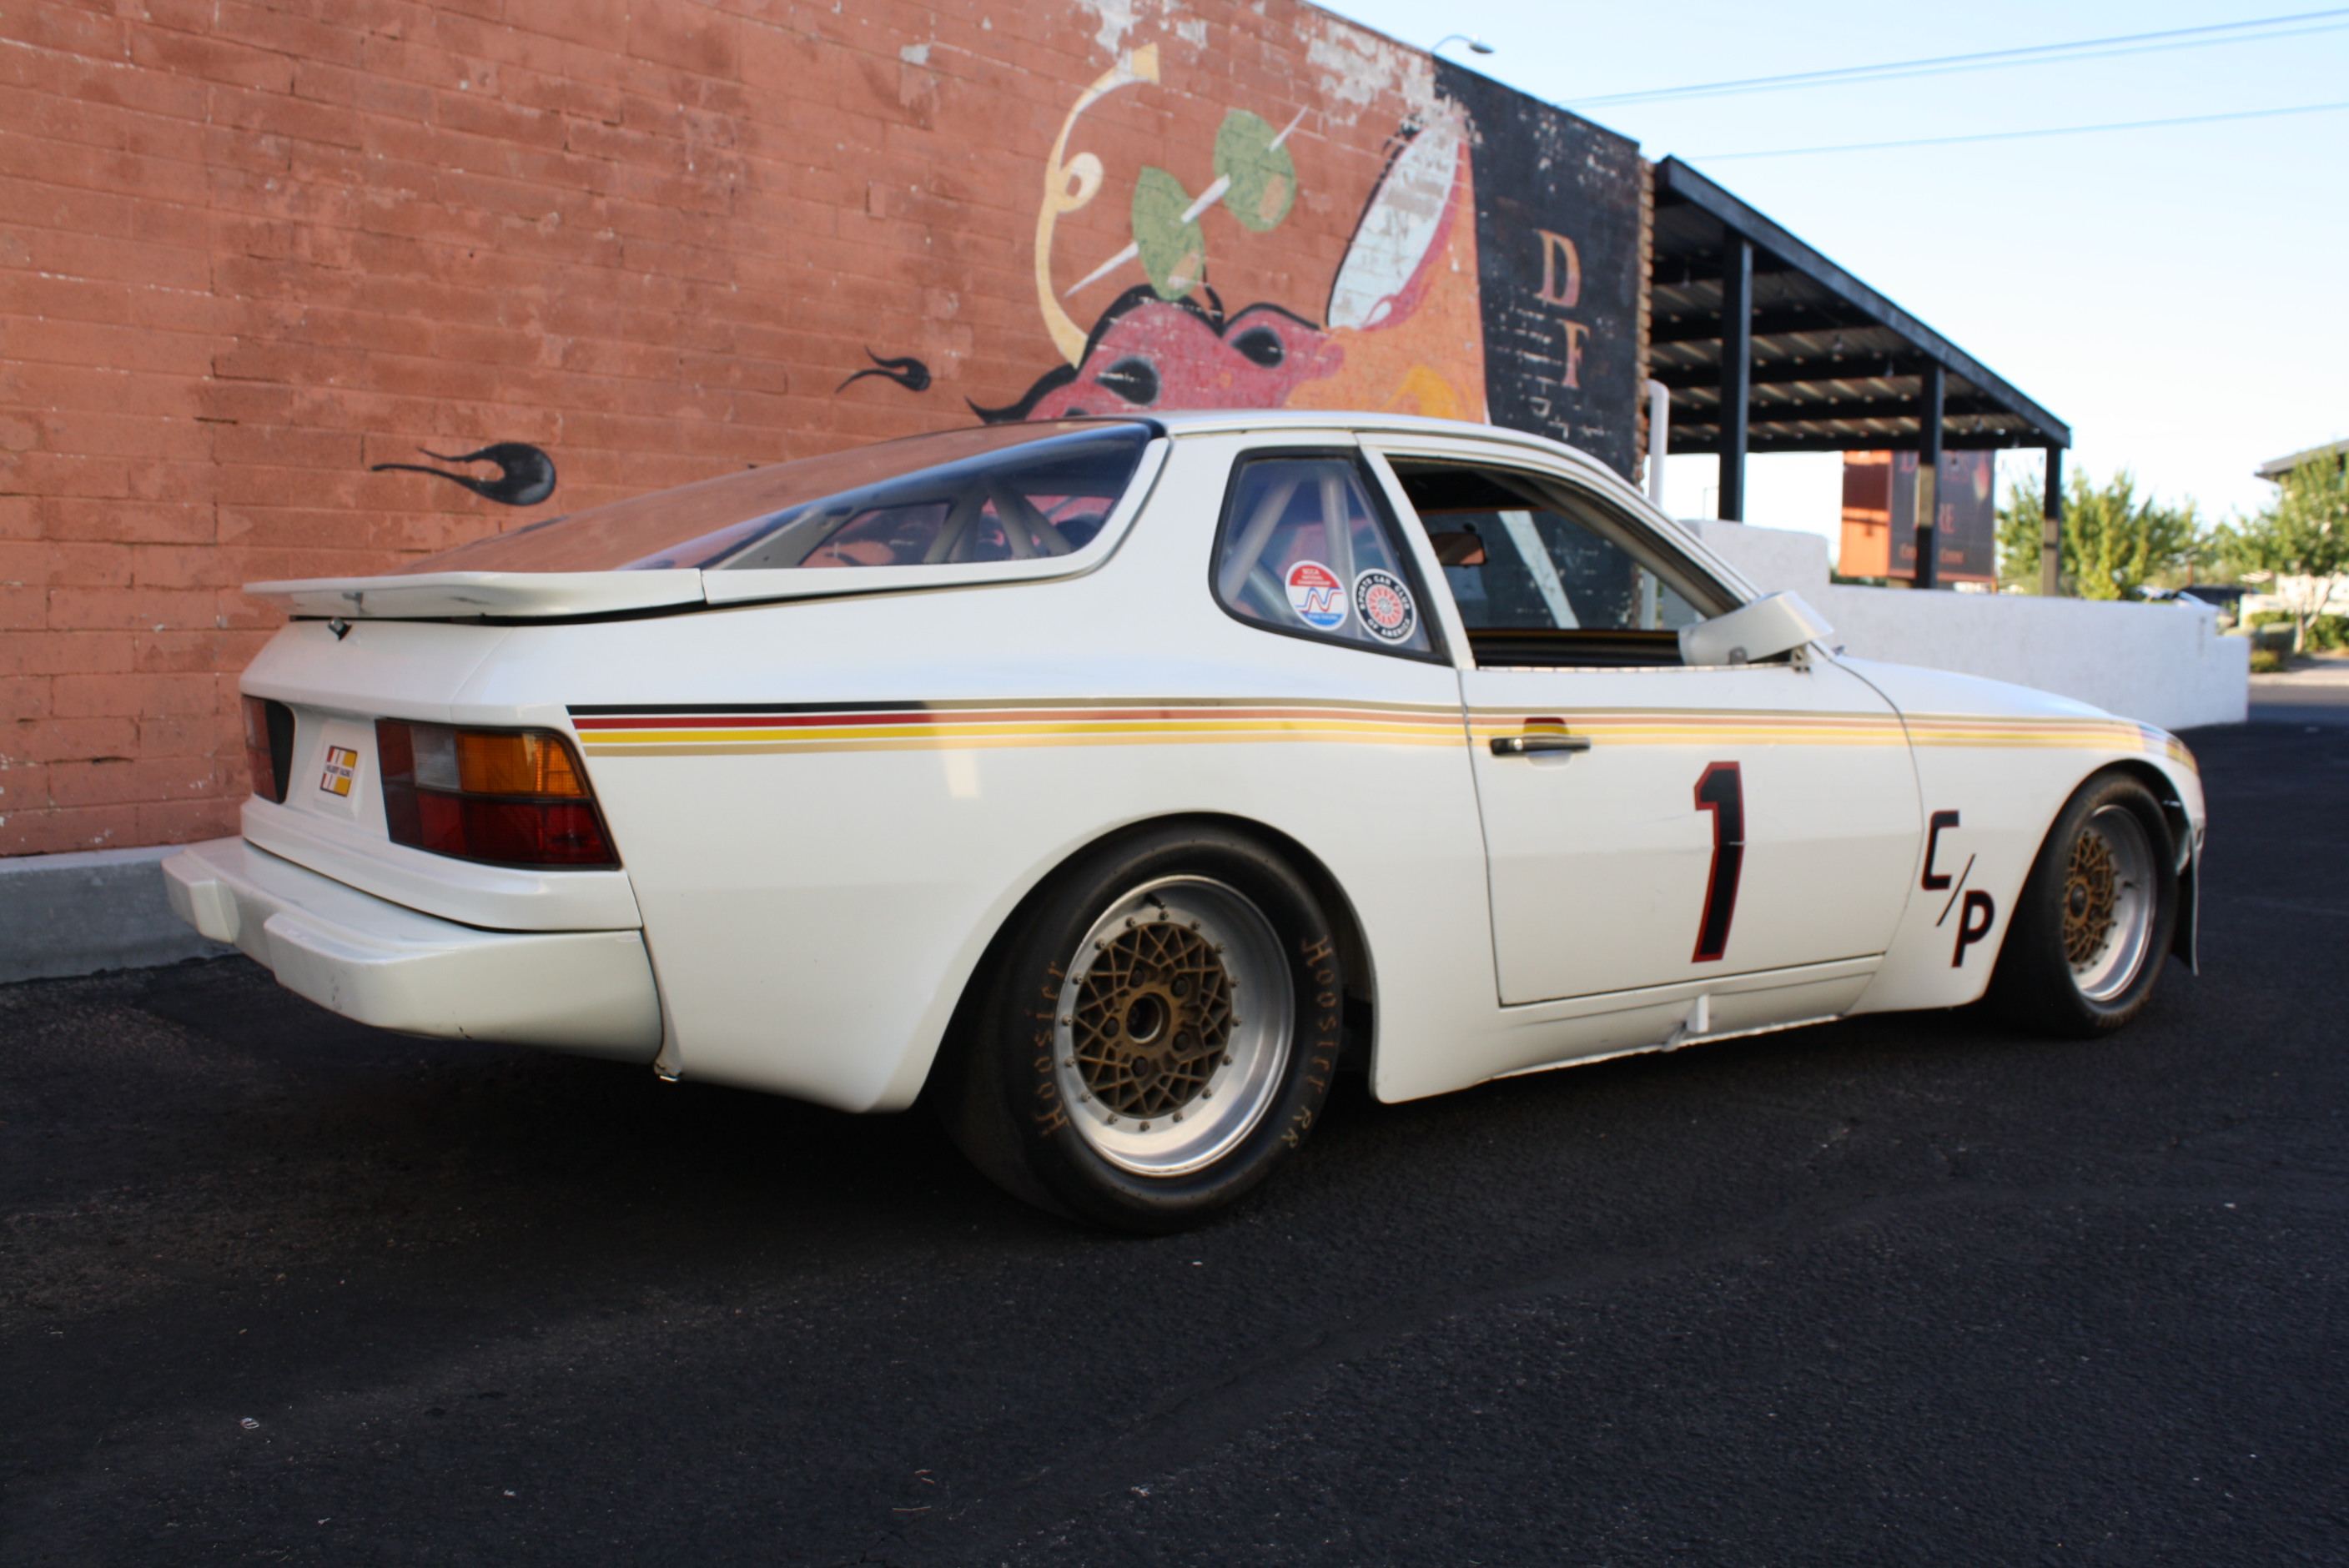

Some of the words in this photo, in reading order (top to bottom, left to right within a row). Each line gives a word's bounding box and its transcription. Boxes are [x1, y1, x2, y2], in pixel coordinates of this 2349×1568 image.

[1533, 229, 1582, 308] D
[1555, 319, 1591, 389] F
[1358, 577, 1372, 610] SPORTS
[1373, 575, 1391, 585] CAR
[1394, 585, 1410, 610] CLUB
[1367, 618, 1379, 629] OF
[1381, 618, 1411, 637] AMERICA
[1691, 761, 1745, 964] 1
[1300, 932, 1338, 1093] Hoosier
